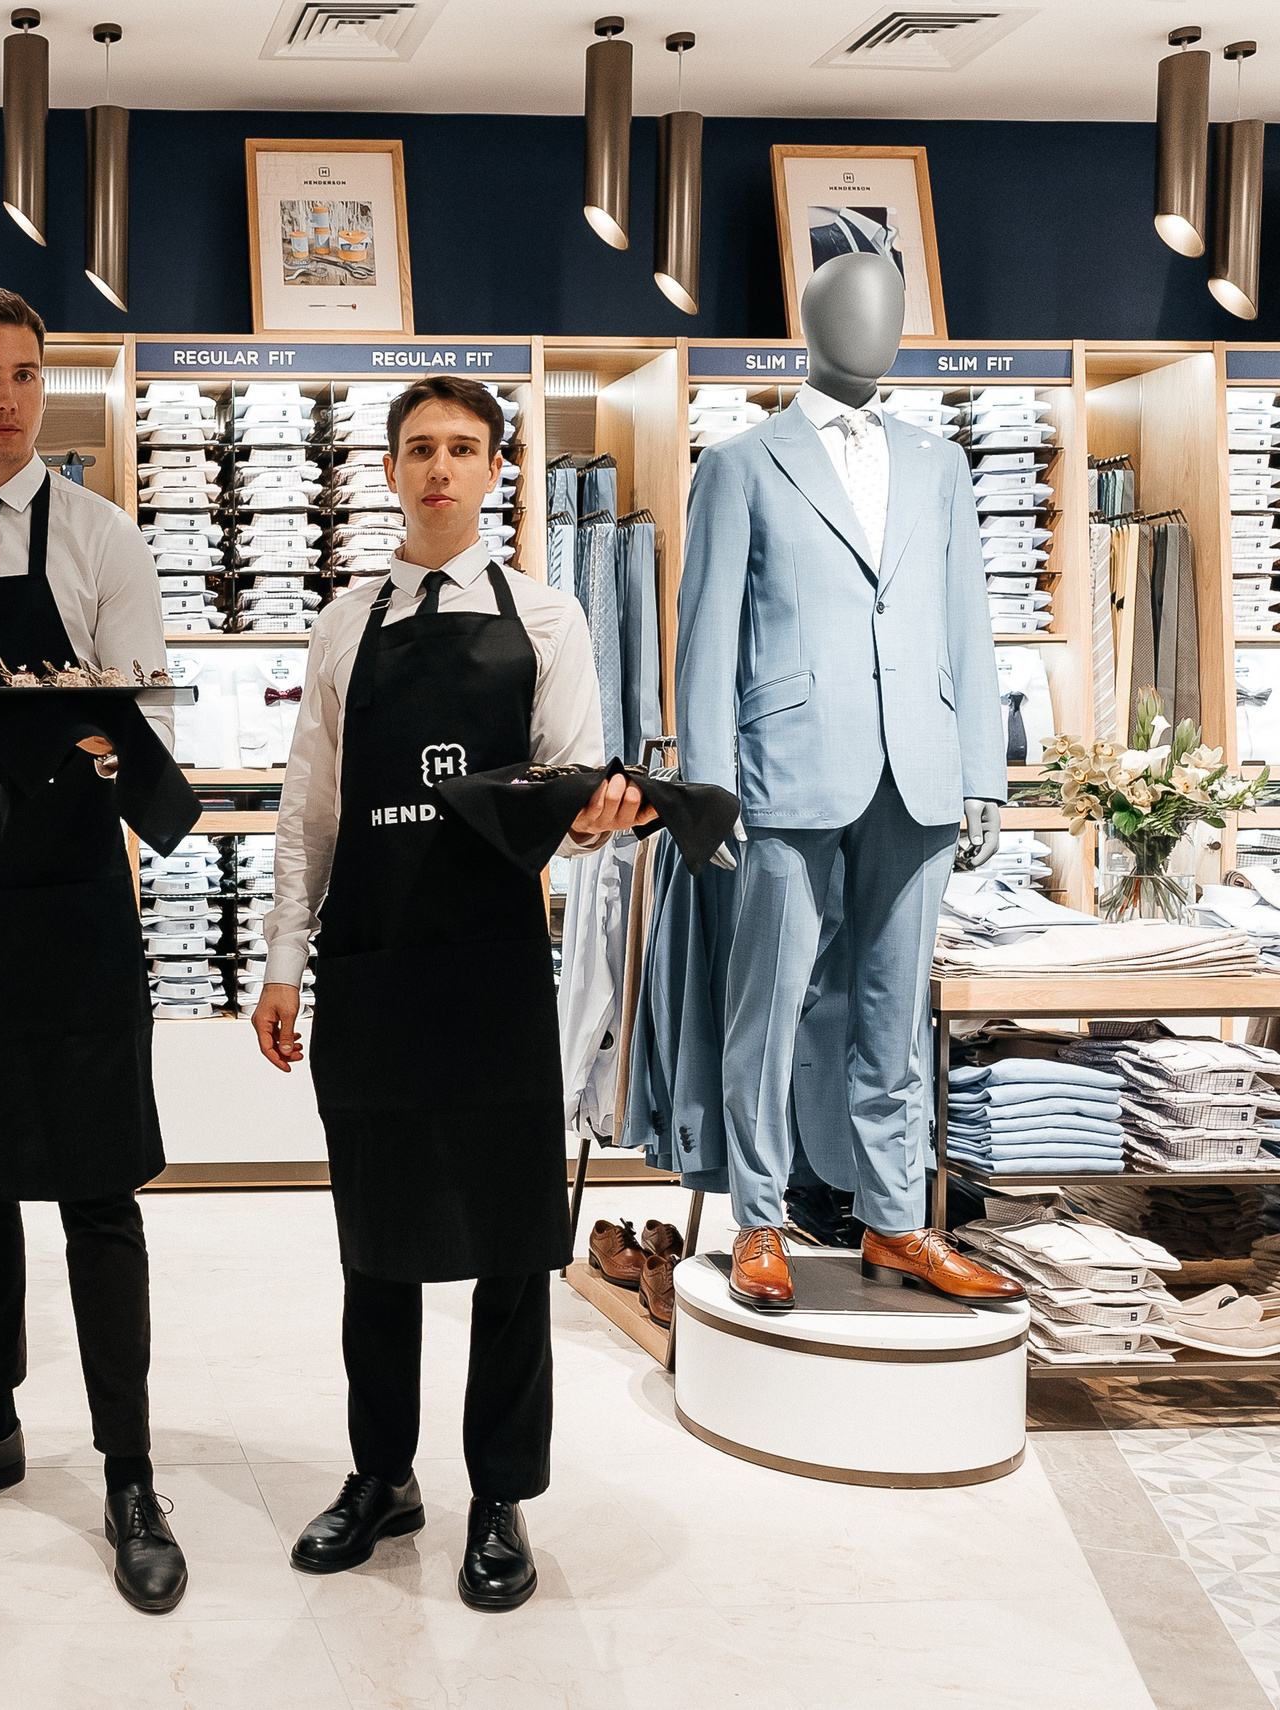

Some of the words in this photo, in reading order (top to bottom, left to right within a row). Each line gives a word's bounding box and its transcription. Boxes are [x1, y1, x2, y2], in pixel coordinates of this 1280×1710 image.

[173, 350, 259, 366] REGULAR
[268, 350, 296, 366] FIT
[372, 351, 457, 367] REGULAR
[466, 351, 493, 367] FIT
[745, 354, 786, 370] SLIM
[937, 356, 978, 371] SLIM
[987, 356, 1014, 371] FIT
[434, 756, 454, 775] H
[371, 804, 444, 827] HEND
